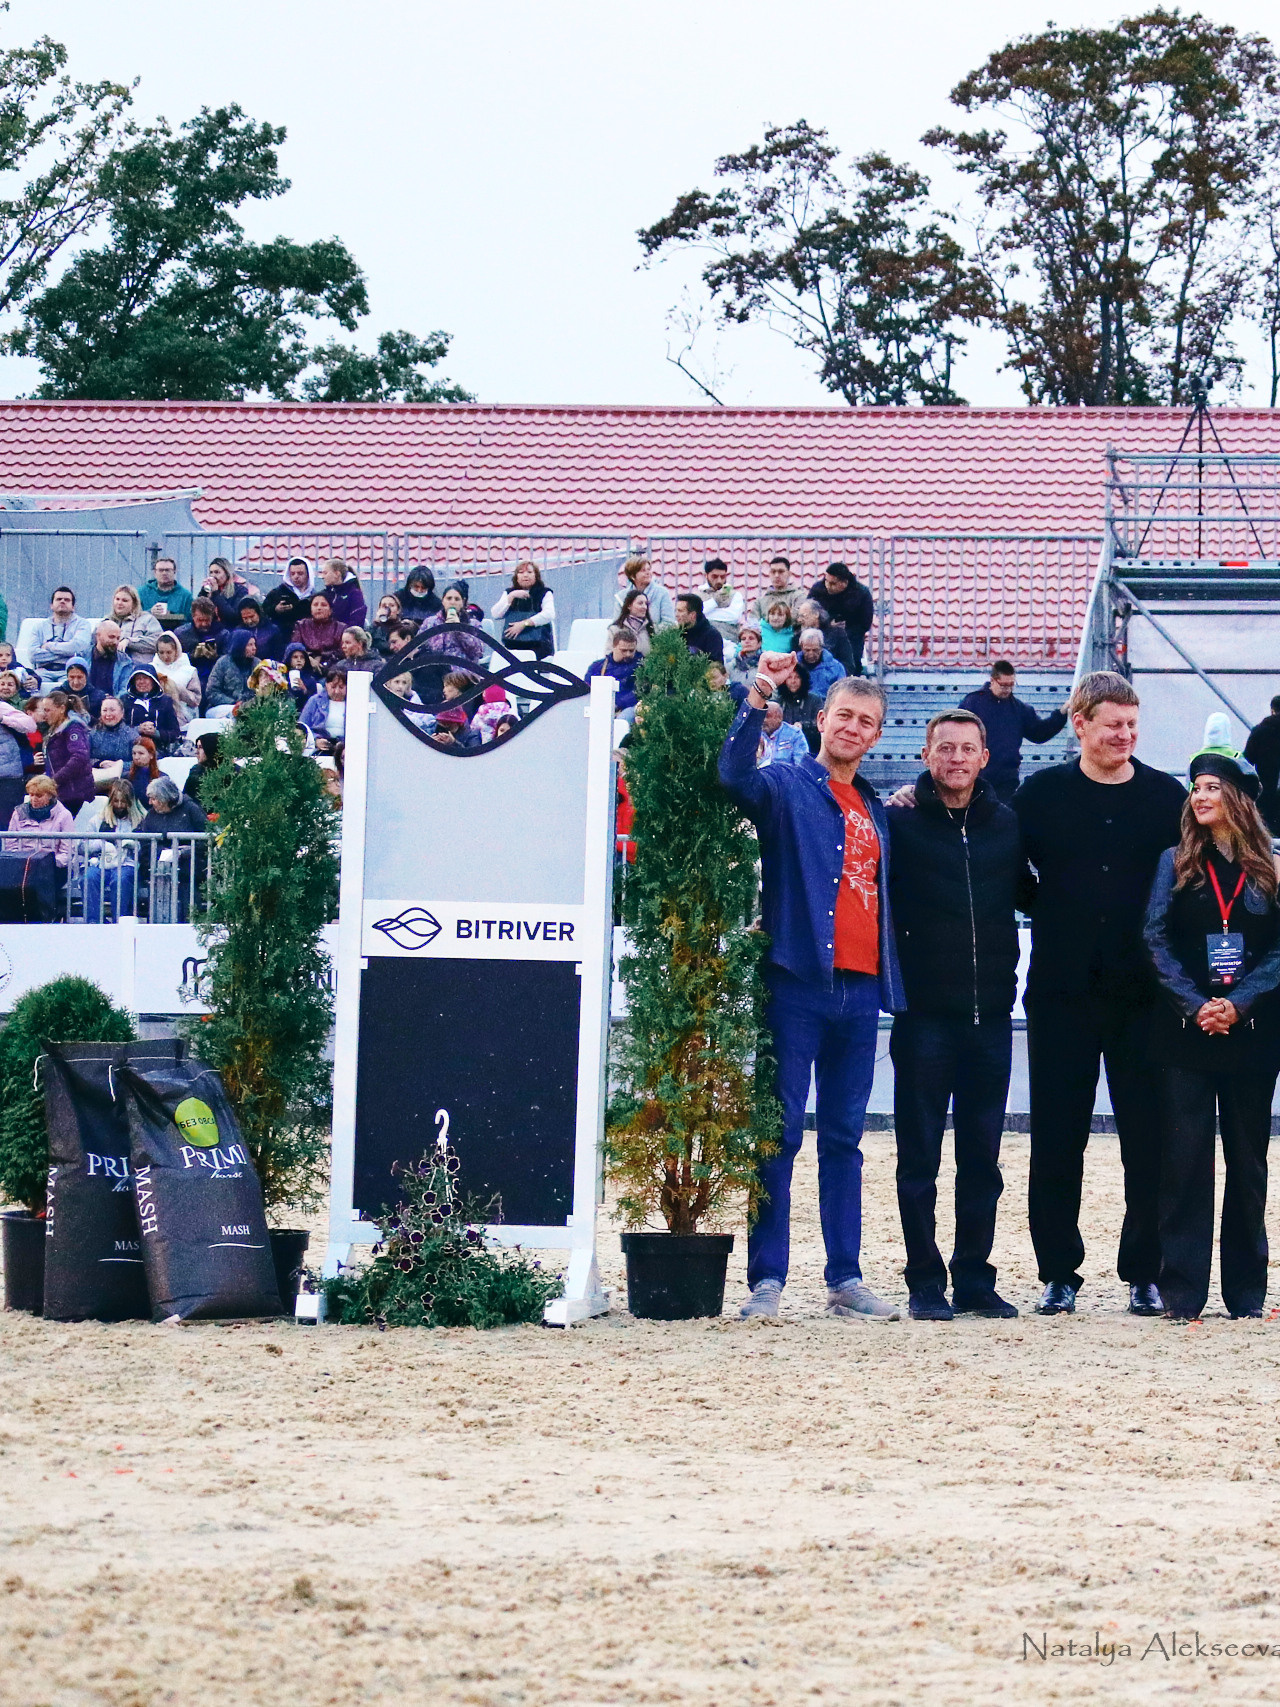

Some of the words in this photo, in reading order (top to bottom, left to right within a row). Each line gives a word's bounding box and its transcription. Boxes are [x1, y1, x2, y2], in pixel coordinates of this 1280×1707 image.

[456, 919, 575, 942] BITRIVER
[179, 1117, 198, 1129] БЕЗ
[86, 1152, 130, 1178] PRI
[45, 1167, 59, 1238] MASH
[134, 1164, 159, 1237] MASH
[221, 1225, 251, 1236] MASH
[114, 1240, 140, 1251] MAS
